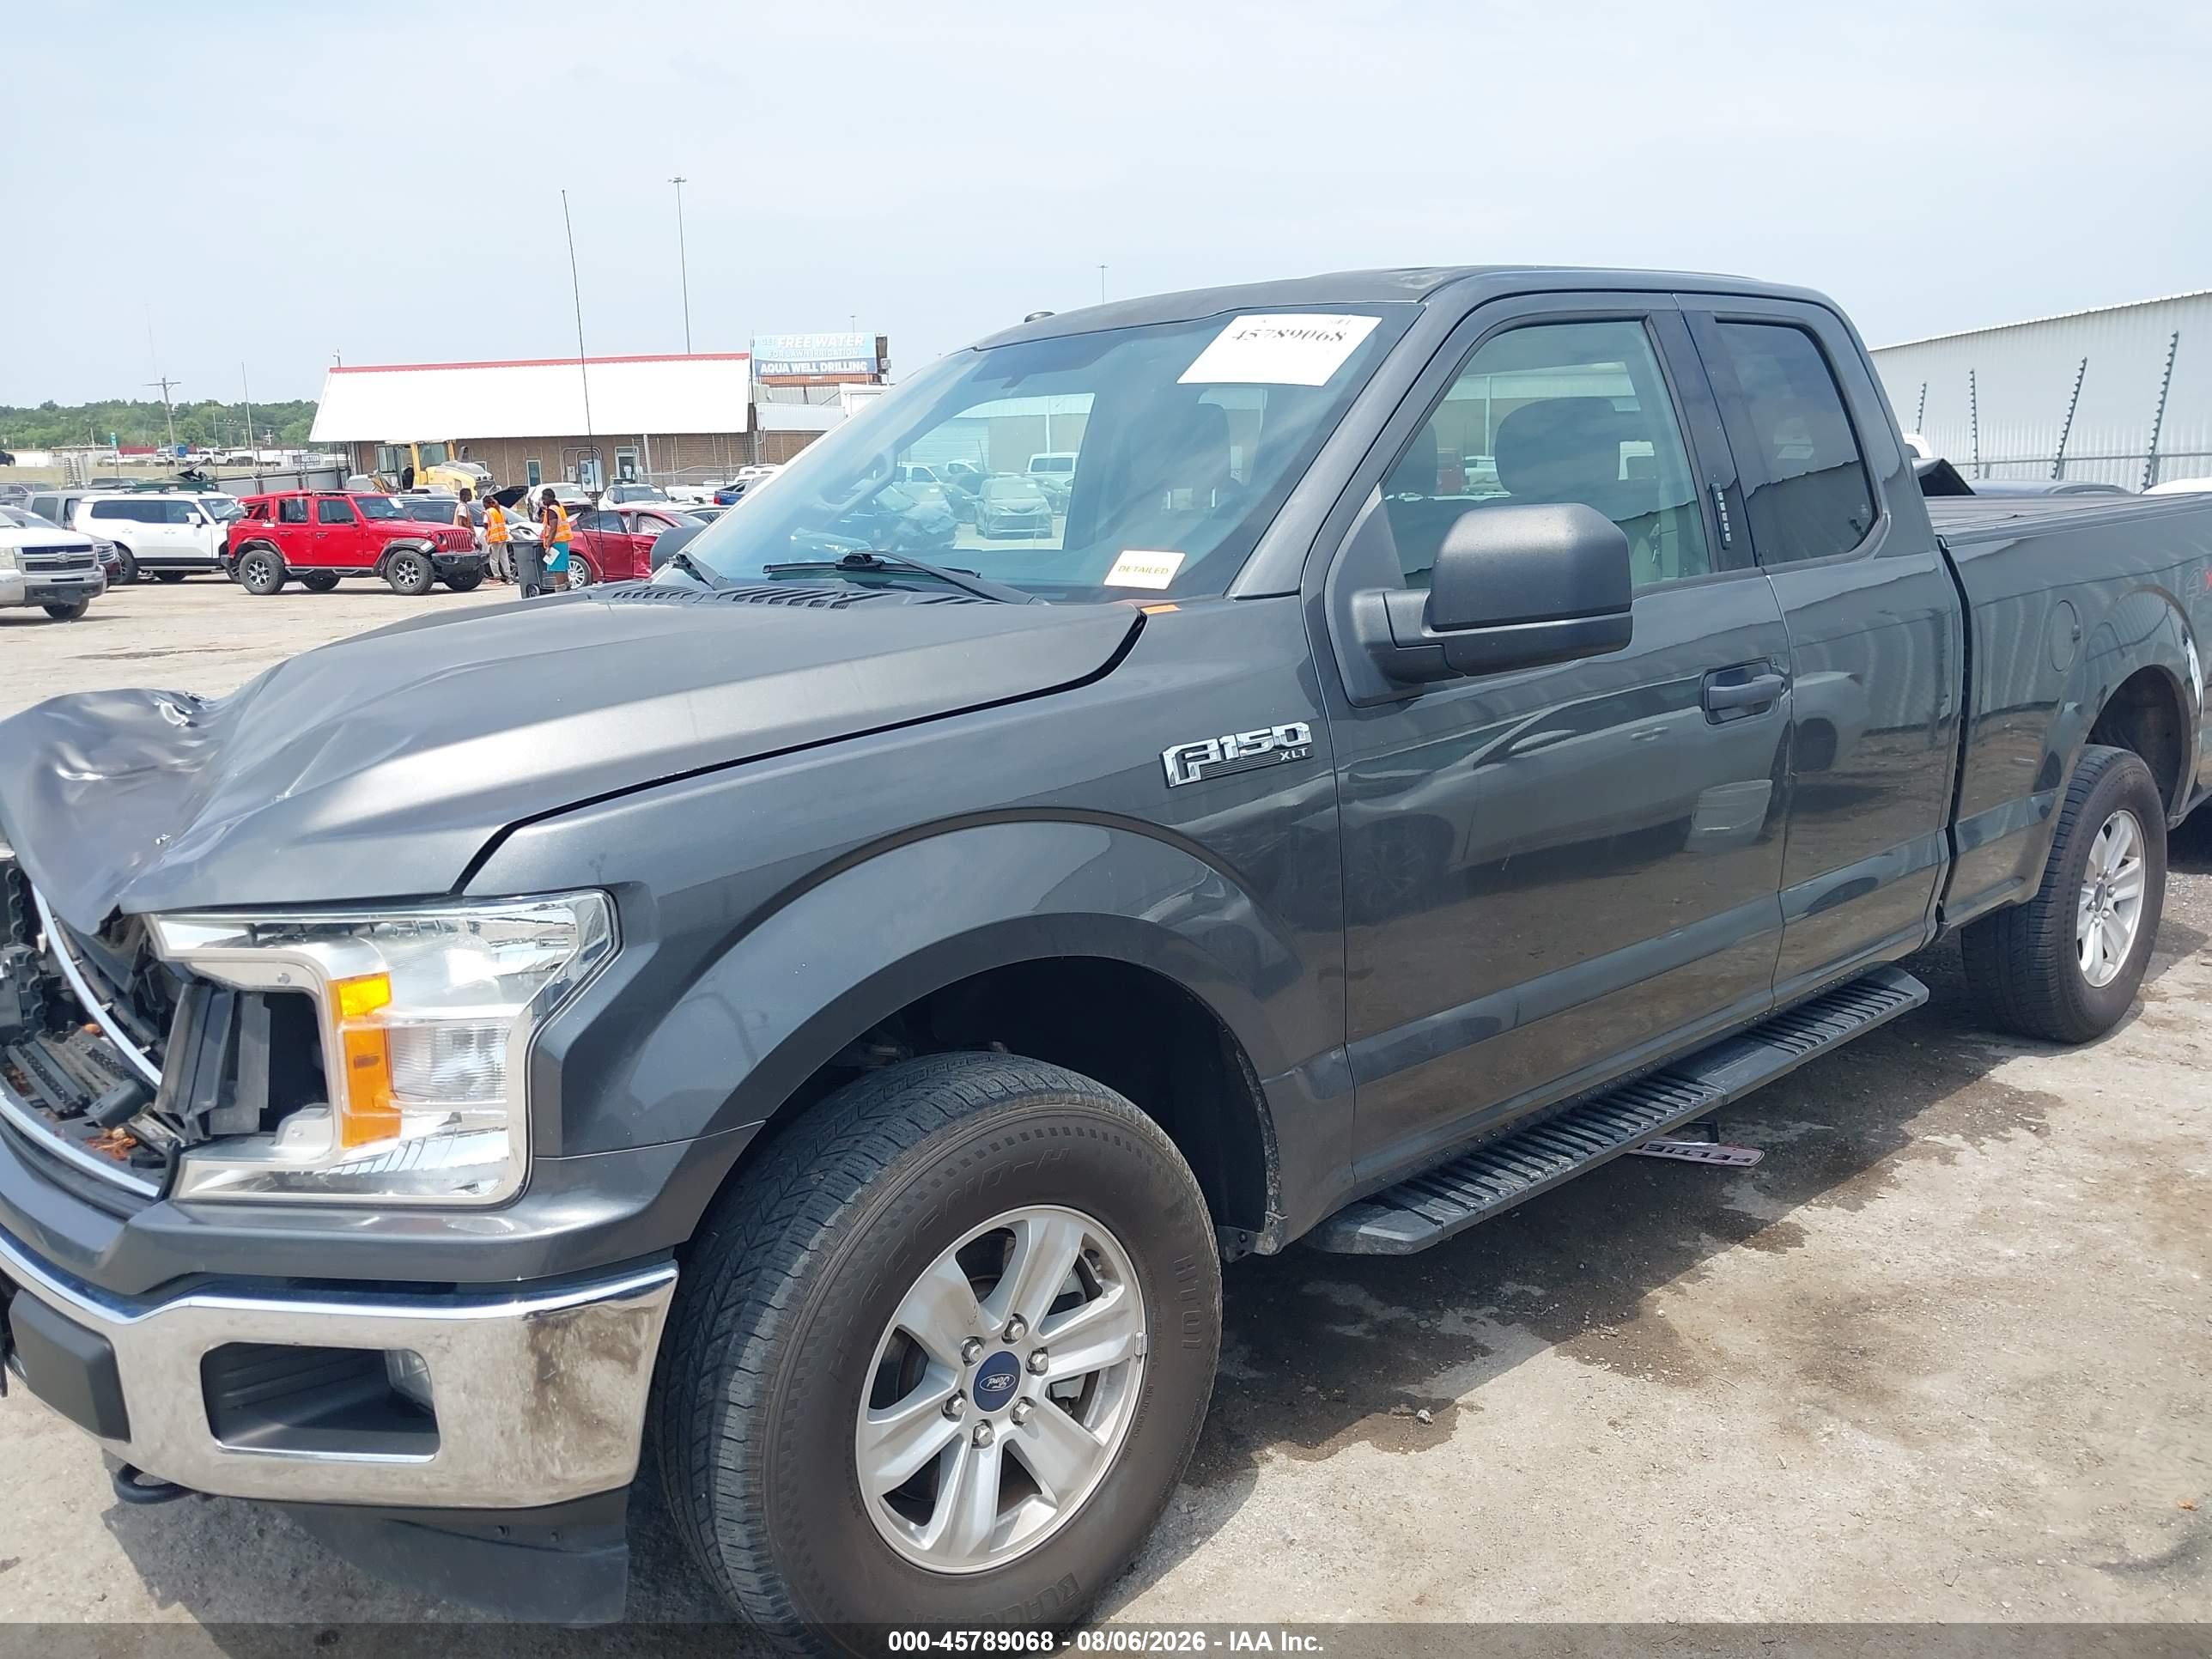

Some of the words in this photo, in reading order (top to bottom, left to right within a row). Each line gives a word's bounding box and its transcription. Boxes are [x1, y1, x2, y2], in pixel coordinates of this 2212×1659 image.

[776, 335, 812, 349] FREE
[814, 334, 866, 349] WATER
[1231, 328, 1348, 343] 45789068
[769, 349, 784, 359] FOR
[785, 349, 810, 359] LAWN
[811, 348, 860, 358] IRRIGATION
[760, 362, 791, 374] AQUA
[791, 362, 818, 373] WELL
[820, 361, 867, 373] DRILLING
[1118, 565, 1169, 574] DETAILED
[1279, 747, 1308, 762] XLT
[987, 1376, 1010, 1389] Ford
